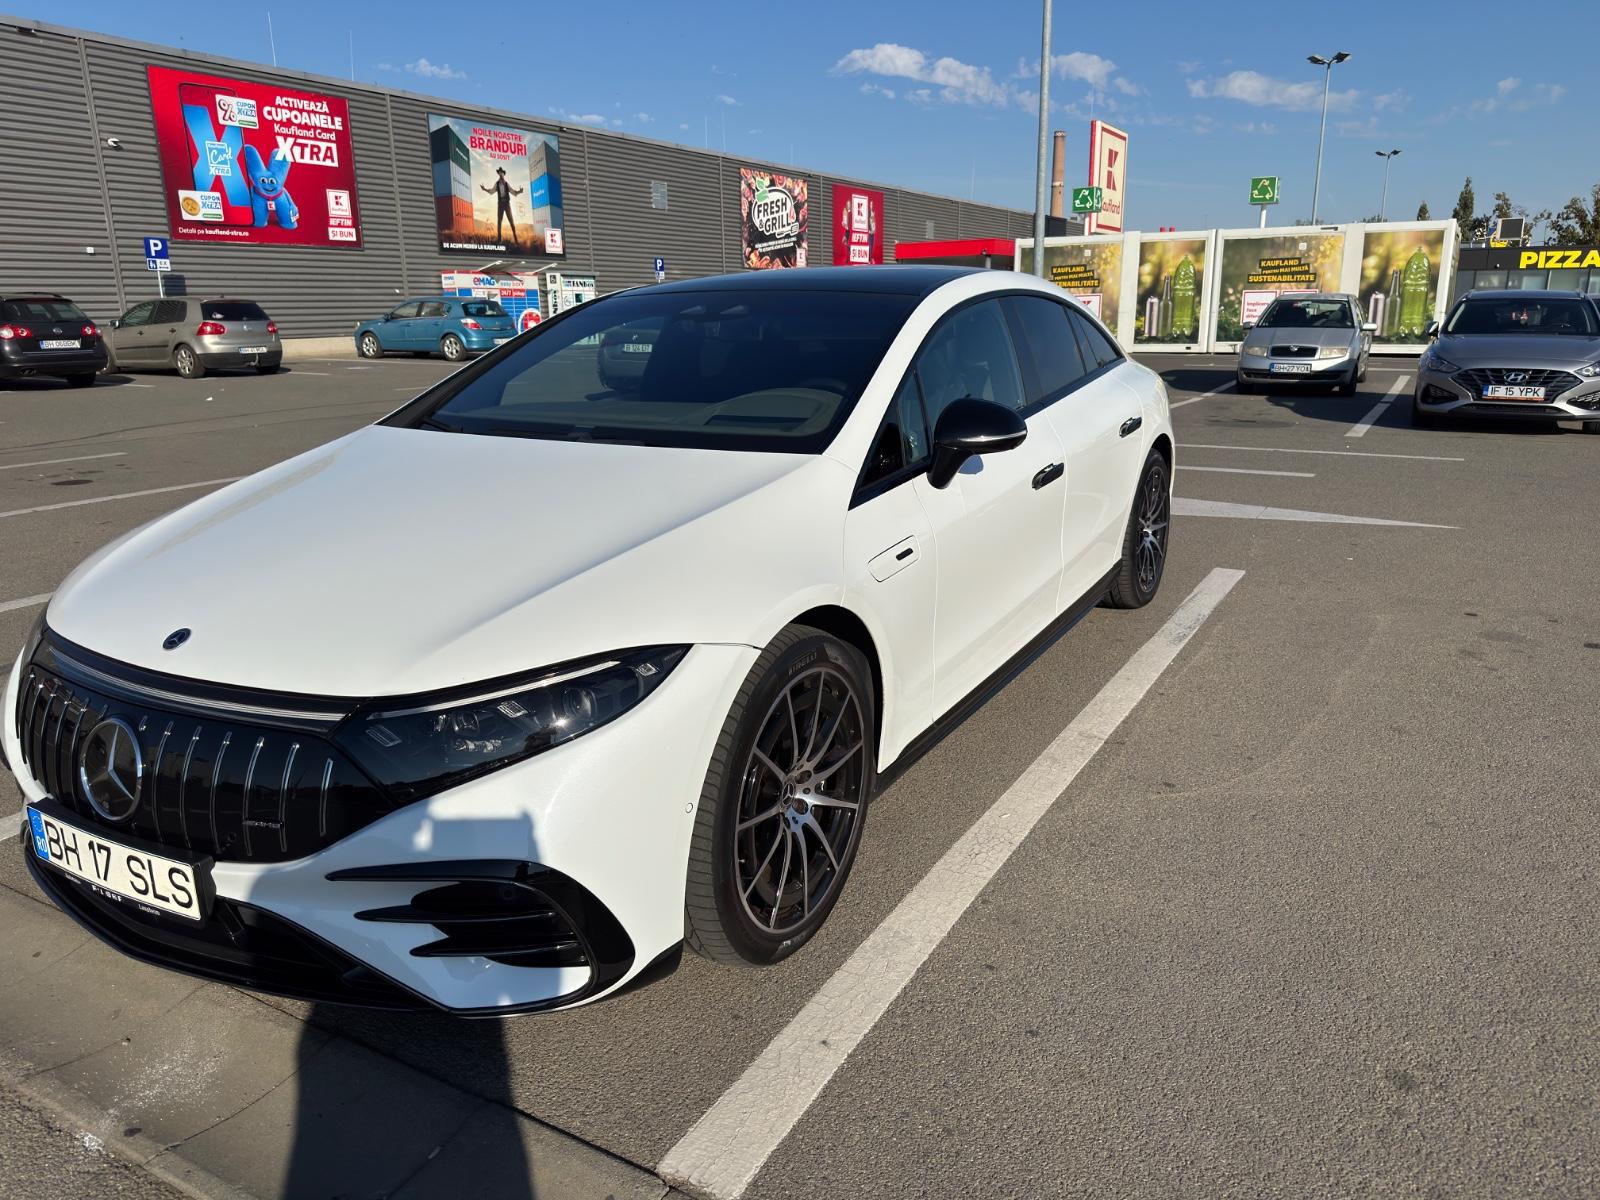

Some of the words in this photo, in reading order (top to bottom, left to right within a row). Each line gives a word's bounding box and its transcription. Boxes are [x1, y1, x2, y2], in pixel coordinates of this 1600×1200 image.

[275, 96, 329, 113] ACTIVEAZĂ
[263, 106, 343, 130] CUPOANELE
[274, 123, 314, 137] Kaufland
[316, 130, 336, 140] Card
[472, 128, 492, 138] NOILE
[493, 131, 523, 142] NOASTRE
[470, 136, 527, 157] BRANDURI
[757, 197, 787, 220] FRESH
[1101, 198, 1121, 215] aufland
[149, 239, 163, 256] P
[656, 259, 662, 270] P
[1519, 250, 1600, 269] PIZZA
[473, 276, 496, 286] eMAG
[1248, 274, 1315, 282] SUSTENABILITATE
[1490, 386, 1501, 396] IF
[1504, 387, 1515, 396] 15
[1518, 387, 1541, 397] YPK
[44, 820, 83, 872] BH
[87, 840, 111, 882] 17
[126, 855, 193, 909] SLS
